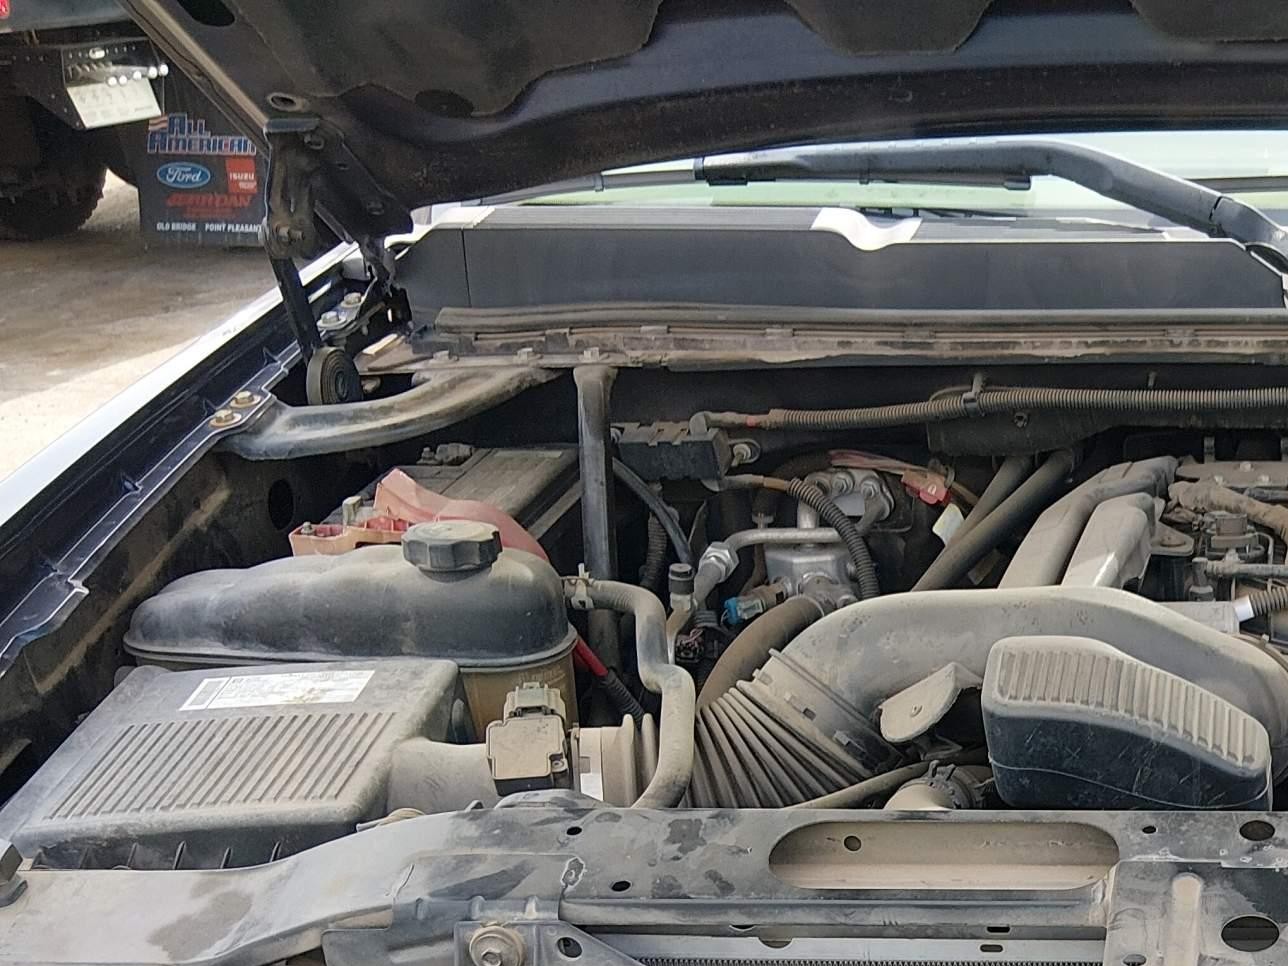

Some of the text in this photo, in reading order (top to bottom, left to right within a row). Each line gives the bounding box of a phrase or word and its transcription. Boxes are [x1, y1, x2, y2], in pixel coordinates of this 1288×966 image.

[166, 167, 202, 183] Ford
[229, 172, 255, 180] ISUZU
[157, 223, 196, 231] OLD BRIDGE
[205, 223, 226, 231] POINT
